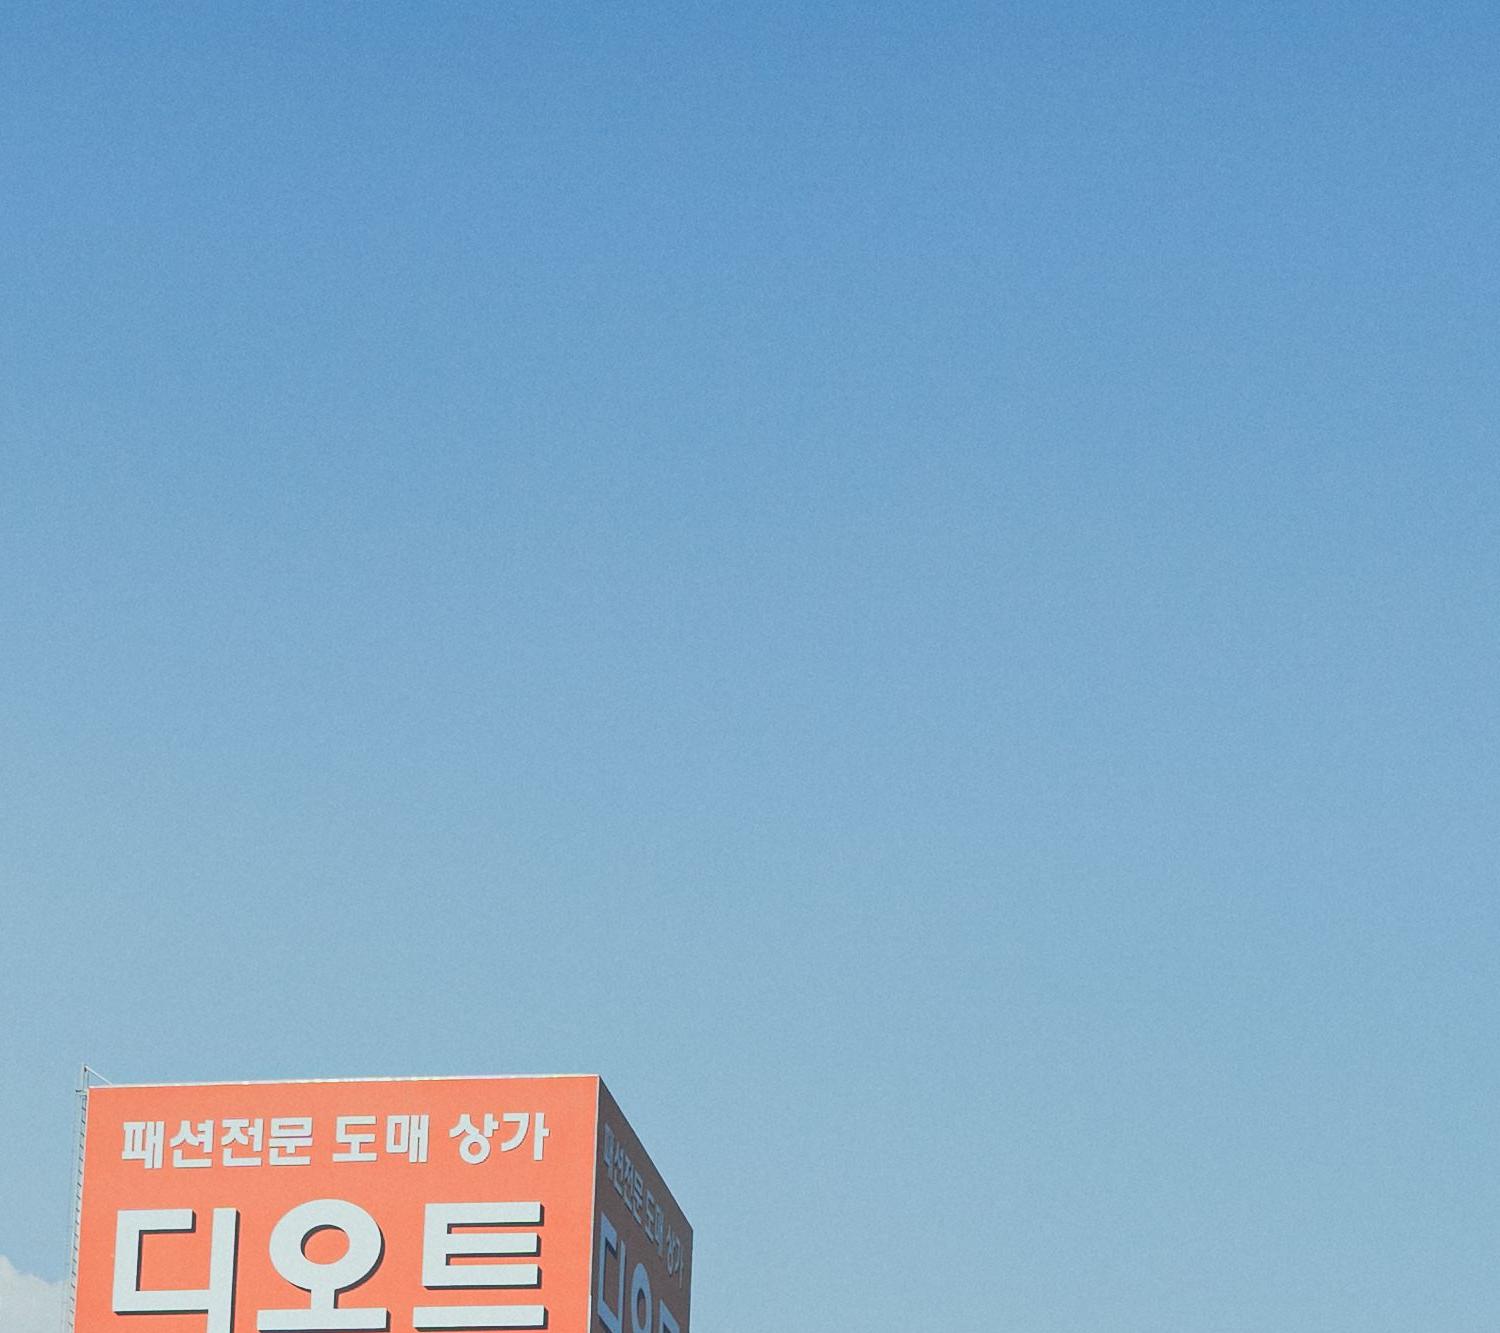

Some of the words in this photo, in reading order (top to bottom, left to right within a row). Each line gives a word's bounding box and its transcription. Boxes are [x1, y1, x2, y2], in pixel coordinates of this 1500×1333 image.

[121, 1116, 313, 1170] 패션전문
[332, 1114, 430, 1165] 도매
[449, 1111, 551, 1166] 상가
